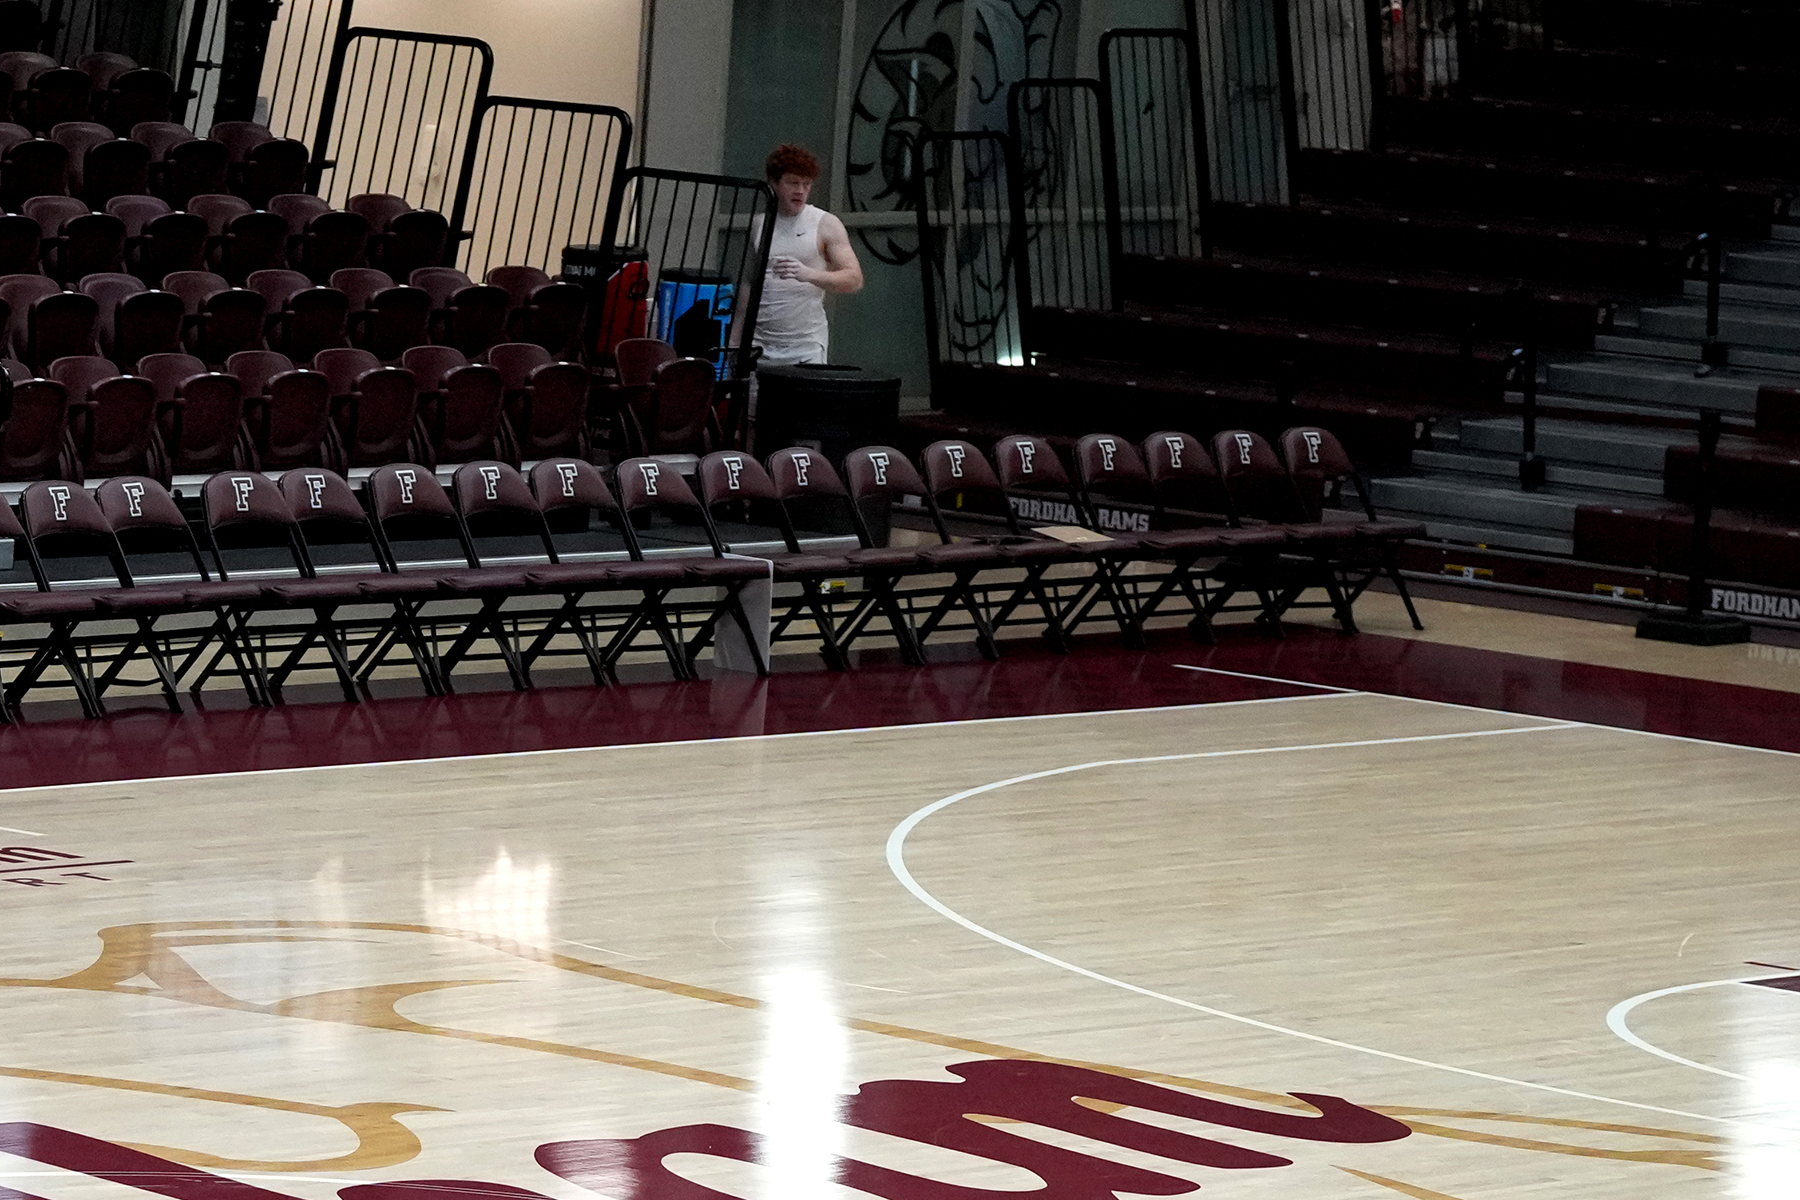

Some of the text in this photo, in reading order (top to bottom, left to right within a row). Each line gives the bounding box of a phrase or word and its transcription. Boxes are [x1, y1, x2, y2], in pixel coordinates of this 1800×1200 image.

[944, 444, 966, 477] F
[1015, 441, 1036, 473] F
[1097, 438, 1117, 471] F
[1164, 436, 1185, 468] F
[1234, 433, 1253, 464] F
[1302, 431, 1322, 463] F
[478, 465, 501, 500] F
[555, 462, 579, 497] F
[637, 462, 660, 496] F
[721, 454, 744, 490] F
[789, 449, 811, 486] F
[867, 451, 890, 485] F
[47, 485, 71, 521] F
[121, 481, 145, 517] F
[230, 476, 255, 512] F
[304, 473, 327, 509] F
[394, 469, 417, 504] F
[1098, 508, 1151, 532] RAMS
